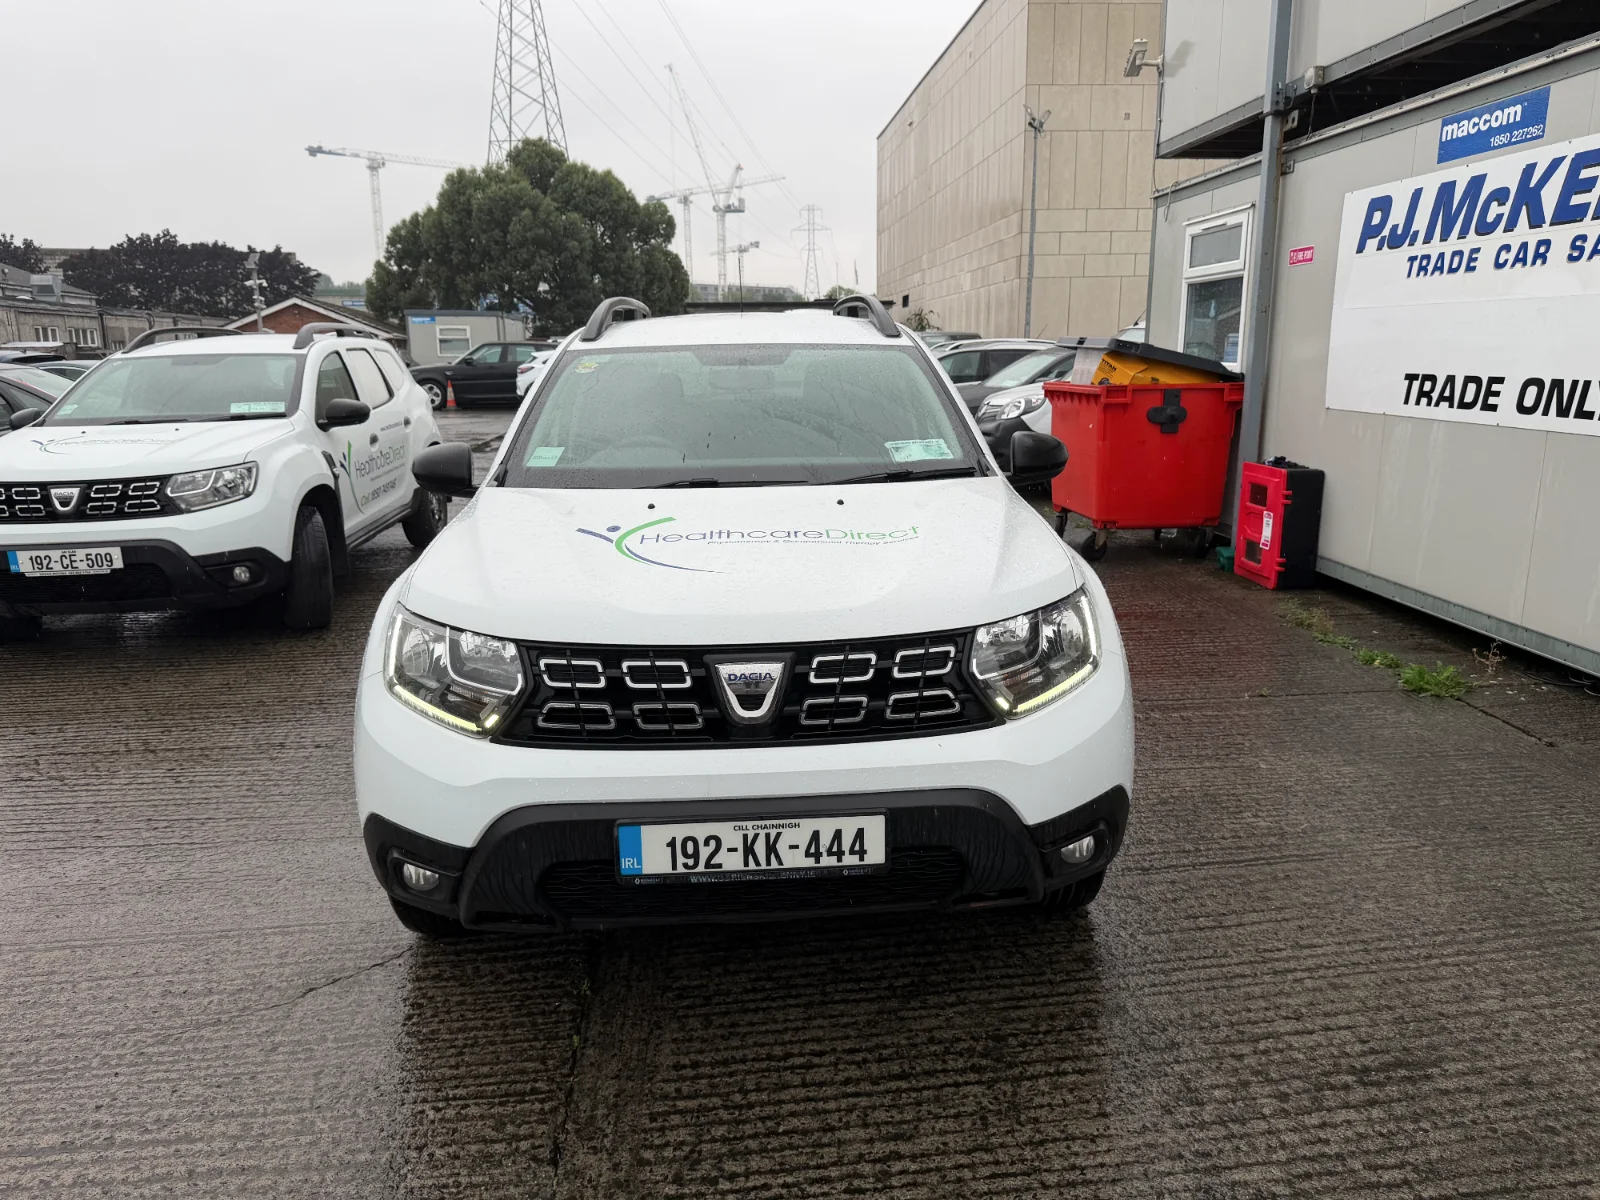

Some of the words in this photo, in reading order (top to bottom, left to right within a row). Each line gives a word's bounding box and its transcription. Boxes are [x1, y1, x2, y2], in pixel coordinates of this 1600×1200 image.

[1441, 103, 1522, 142] maccom
[1489, 132, 1510, 147] 1850
[1511, 124, 1544, 142] 227262
[1406, 246, 1481, 279] TRADE
[1493, 238, 1552, 270] CAR
[1101, 358, 1117, 371] TITAN
[1403, 373, 1506, 412] TRADE
[1516, 377, 1600, 421] ONL
[640, 525, 919, 545] HealthcareDirect
[28, 552, 114, 571] 192-CE-509
[728, 672, 773, 681] DACIA
[733, 824, 751, 832] CILL
[751, 822, 801, 831] CHAINNIGH
[665, 827, 868, 872] 192-KK-444
[621, 857, 642, 869] IRL
